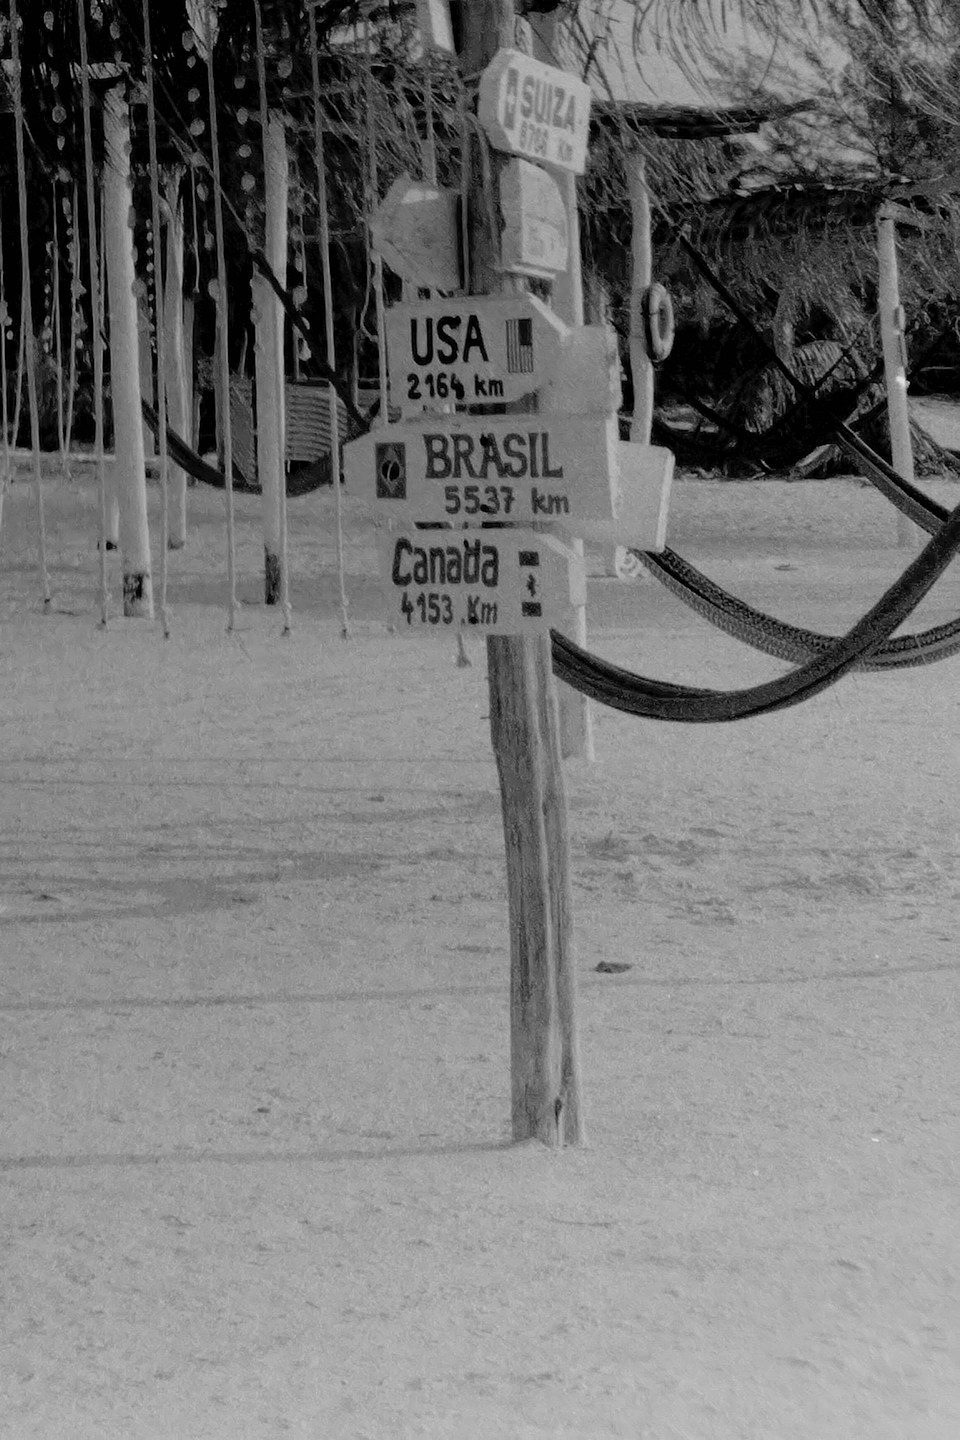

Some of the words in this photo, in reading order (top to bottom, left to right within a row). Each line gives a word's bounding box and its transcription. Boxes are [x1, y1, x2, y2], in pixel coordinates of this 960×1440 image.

[520, 75, 576, 134] SUIZA
[410, 315, 489, 365] USA
[407, 373, 465, 400] 2164
[474, 374, 504, 398] km
[423, 432, 564, 478] BRASIL
[444, 485, 514, 514] 5537
[531, 488, 569, 513] km
[392, 538, 499, 587] Canada
[400, 592, 454, 624] 4153
